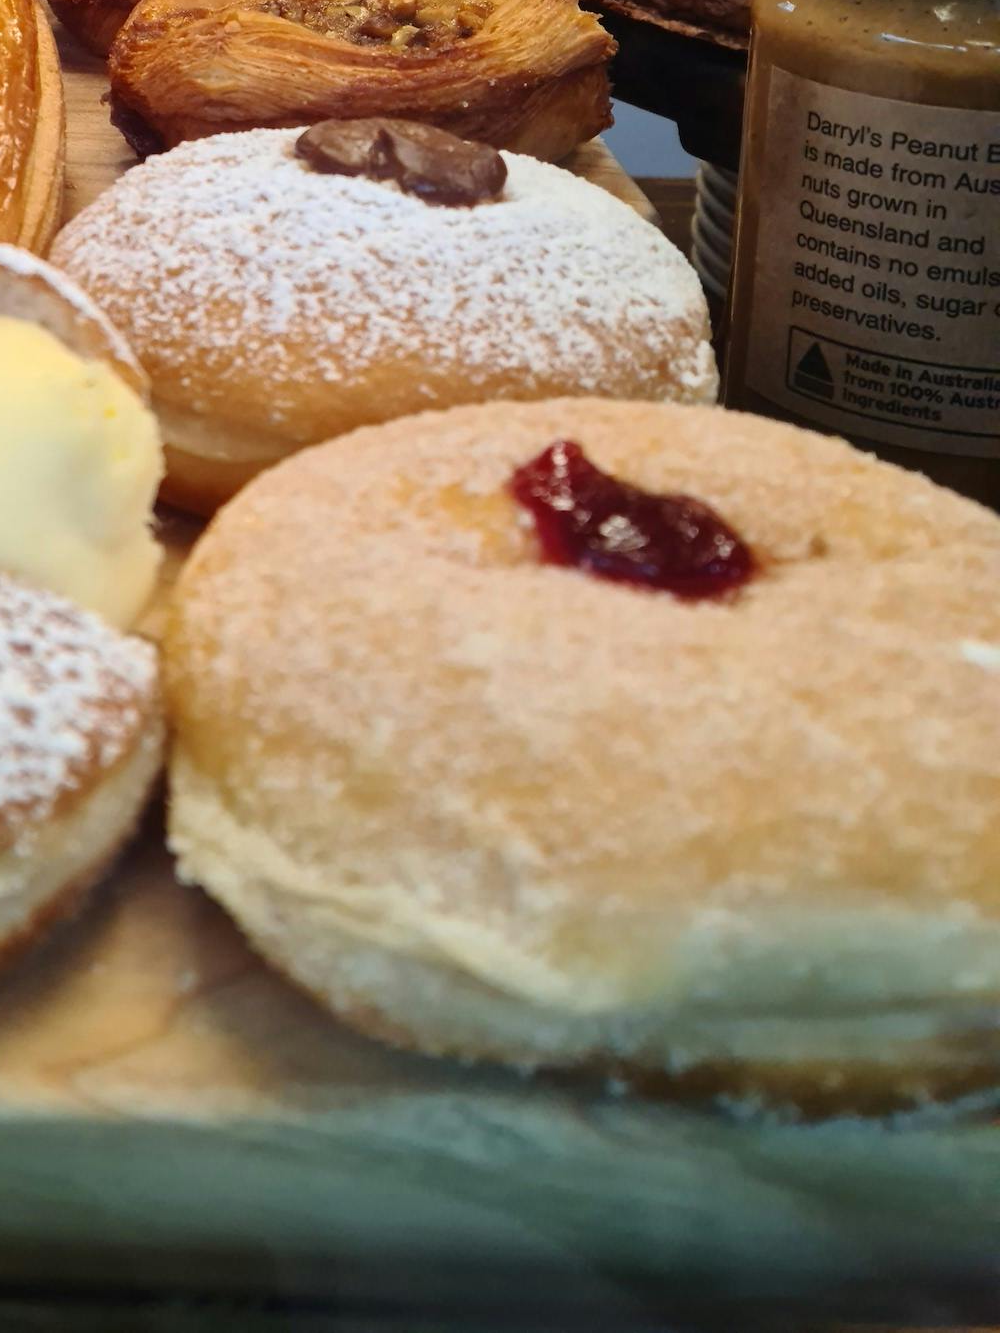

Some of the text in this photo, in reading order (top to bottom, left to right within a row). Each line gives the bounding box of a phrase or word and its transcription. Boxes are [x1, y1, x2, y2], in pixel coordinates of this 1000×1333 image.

[807, 111, 882, 147] Darryl's
[891, 132, 979, 162] Peanut
[804, 140, 818, 162] is
[824, 151, 883, 179] made
[891, 163, 946, 189] from
[801, 174, 947, 220] nuts grown in
[799, 200, 985, 255] Queensland and
[797, 233, 881, 270] contains
[889, 257, 919, 277] no
[794, 260, 855, 293] added
[862, 281, 906, 309] oils,
[916, 293, 987, 318] sugar
[791, 289, 941, 342] preservatives.
[843, 370, 884, 393] from
[889, 382, 944, 404] 100%
[845, 353, 890, 376] Made
[896, 365, 912, 380] in
